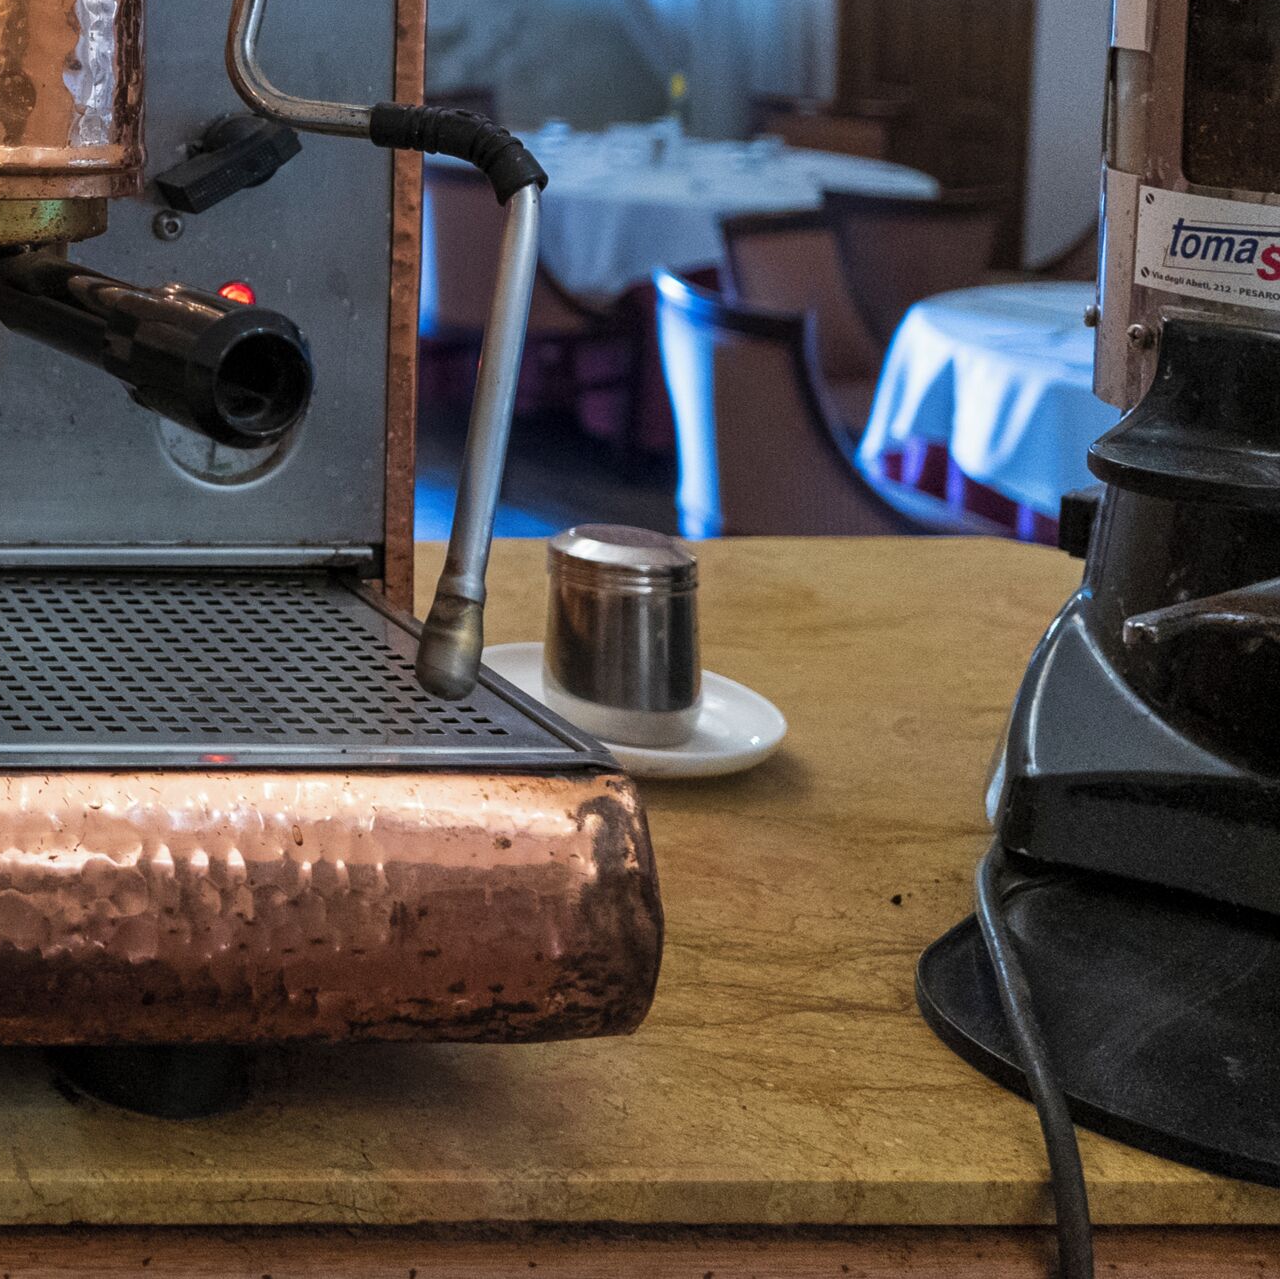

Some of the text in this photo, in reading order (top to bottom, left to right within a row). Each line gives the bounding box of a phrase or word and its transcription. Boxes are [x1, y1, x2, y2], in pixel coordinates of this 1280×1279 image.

[1152, 271, 1163, 280] Via
[1164, 274, 1185, 285] degli
[1213, 283, 1231, 293] 212
[1239, 287, 1280, 300] PESARO
